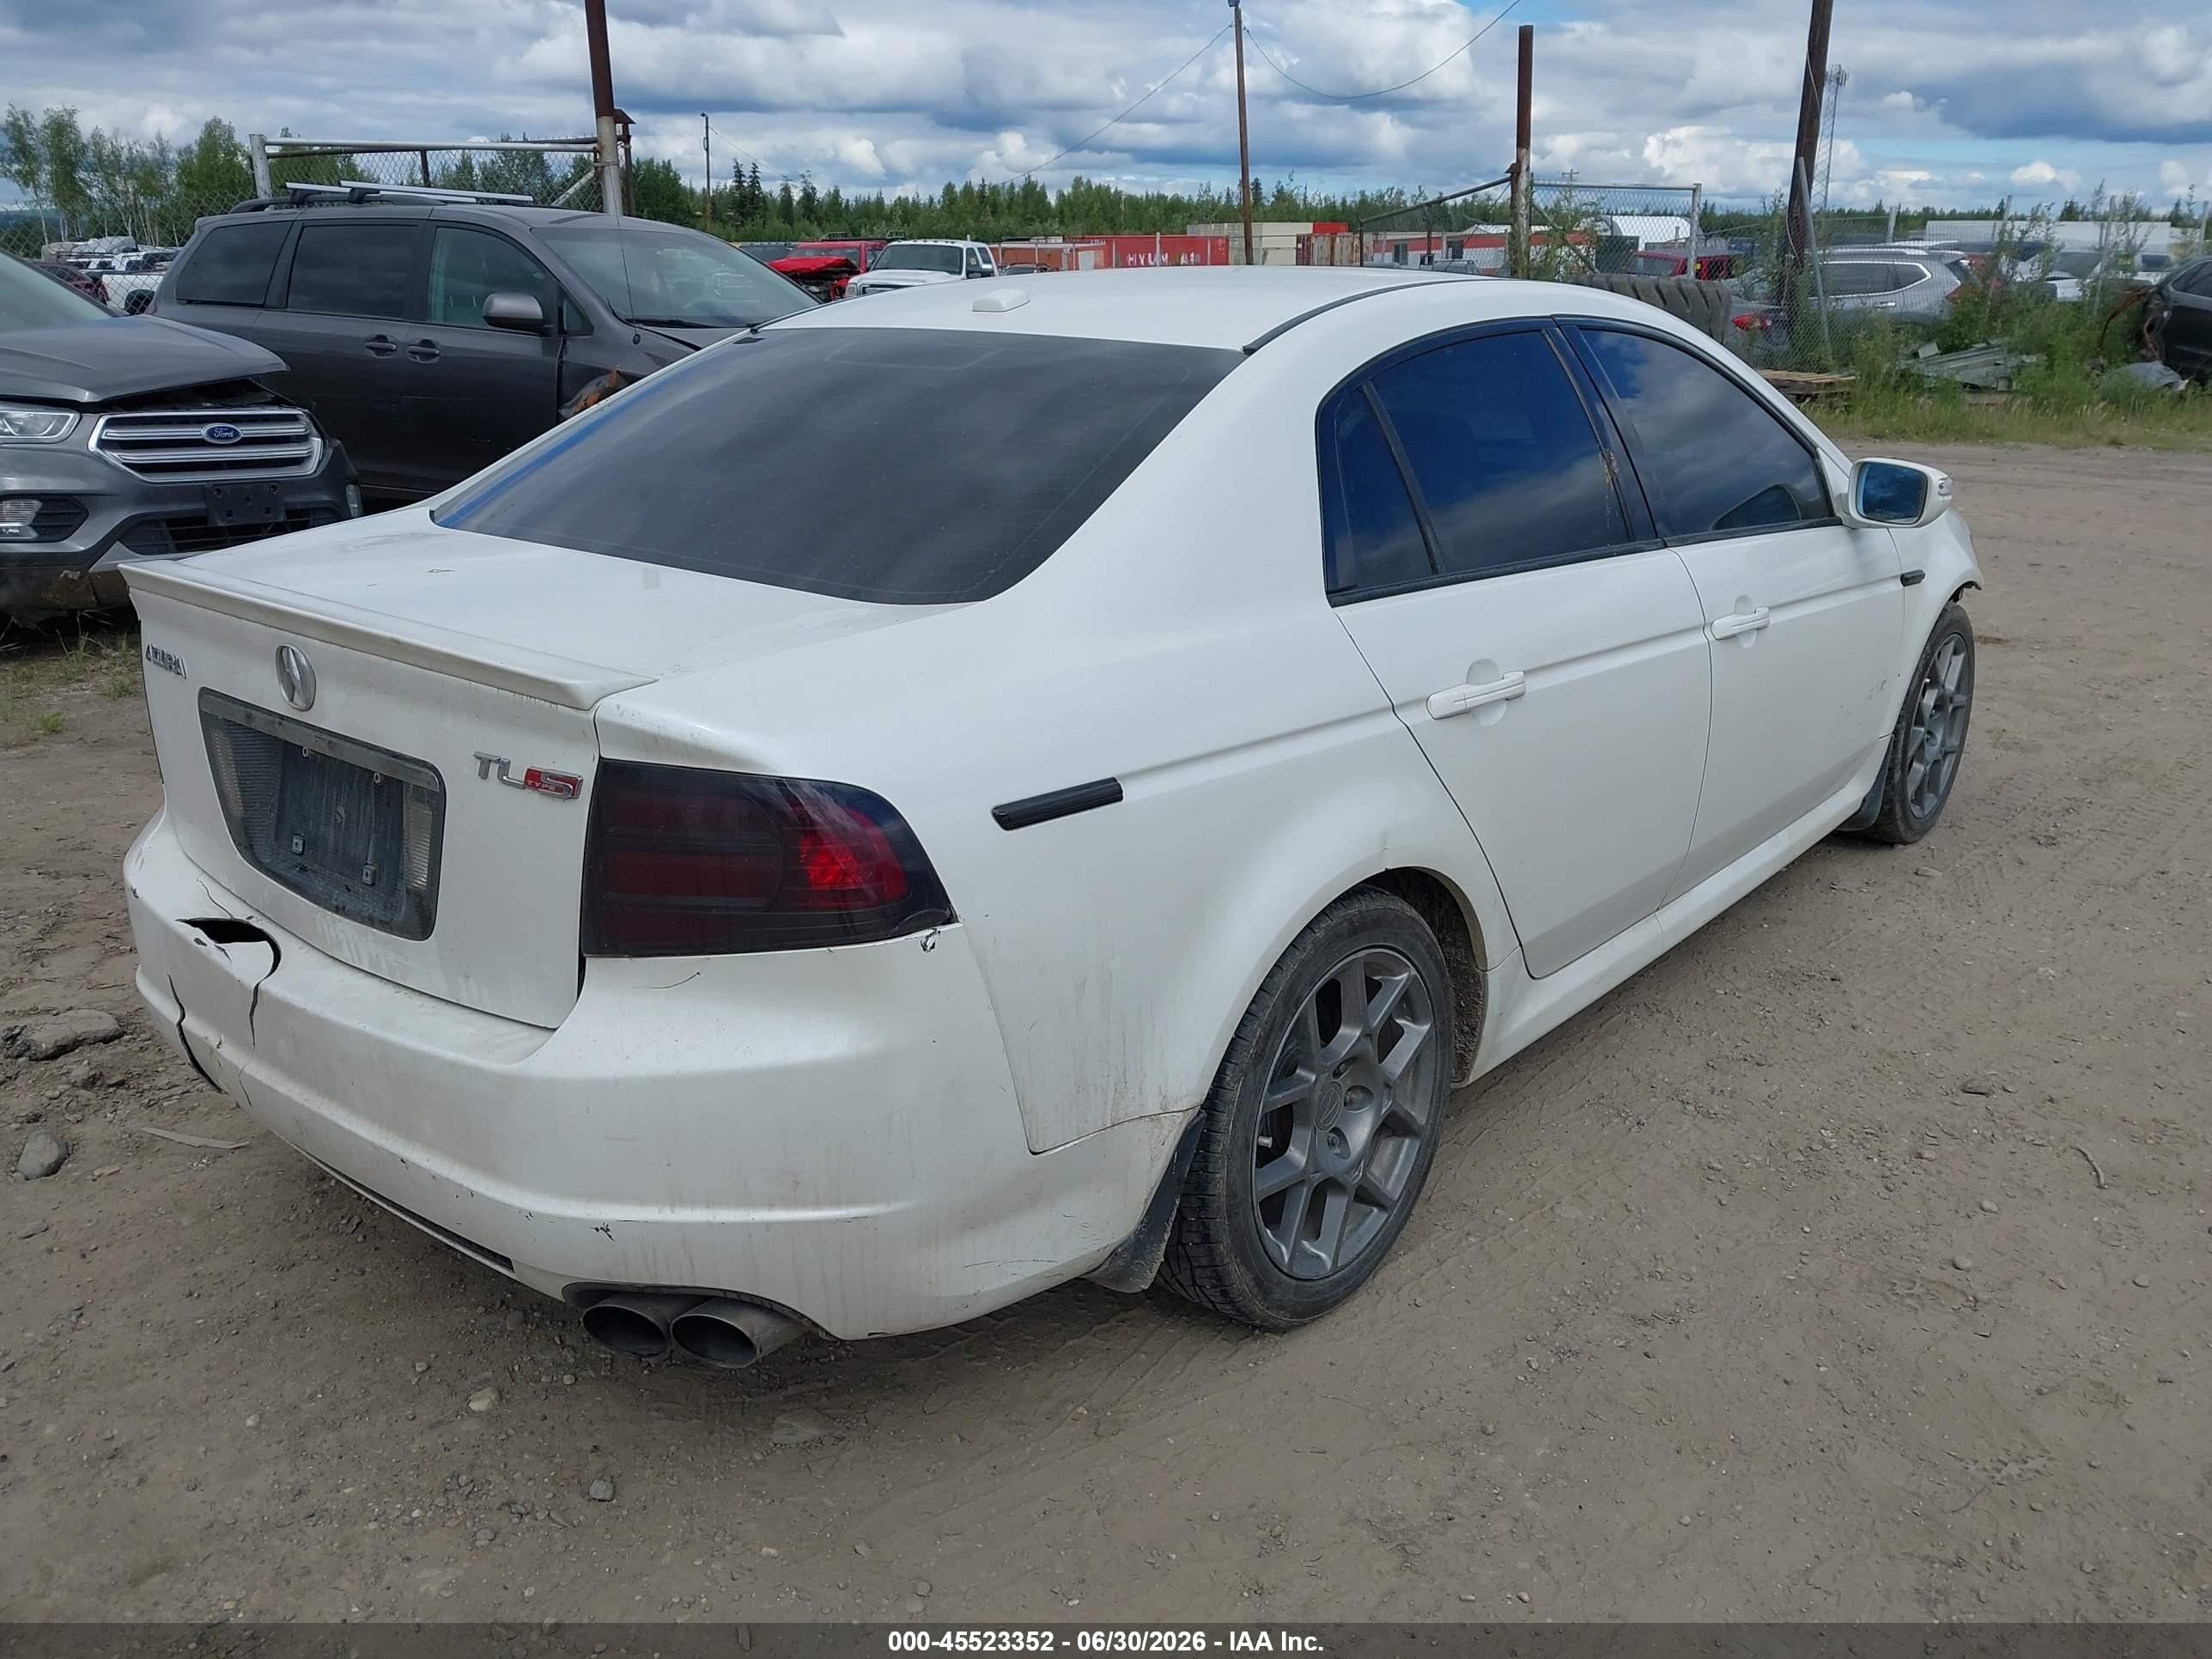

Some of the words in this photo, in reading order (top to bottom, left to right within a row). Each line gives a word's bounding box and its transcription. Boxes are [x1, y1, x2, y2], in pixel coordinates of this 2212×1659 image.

[214, 428, 234, 438] Ford
[145, 643, 187, 680] ACURA
[473, 750, 526, 790] TL
